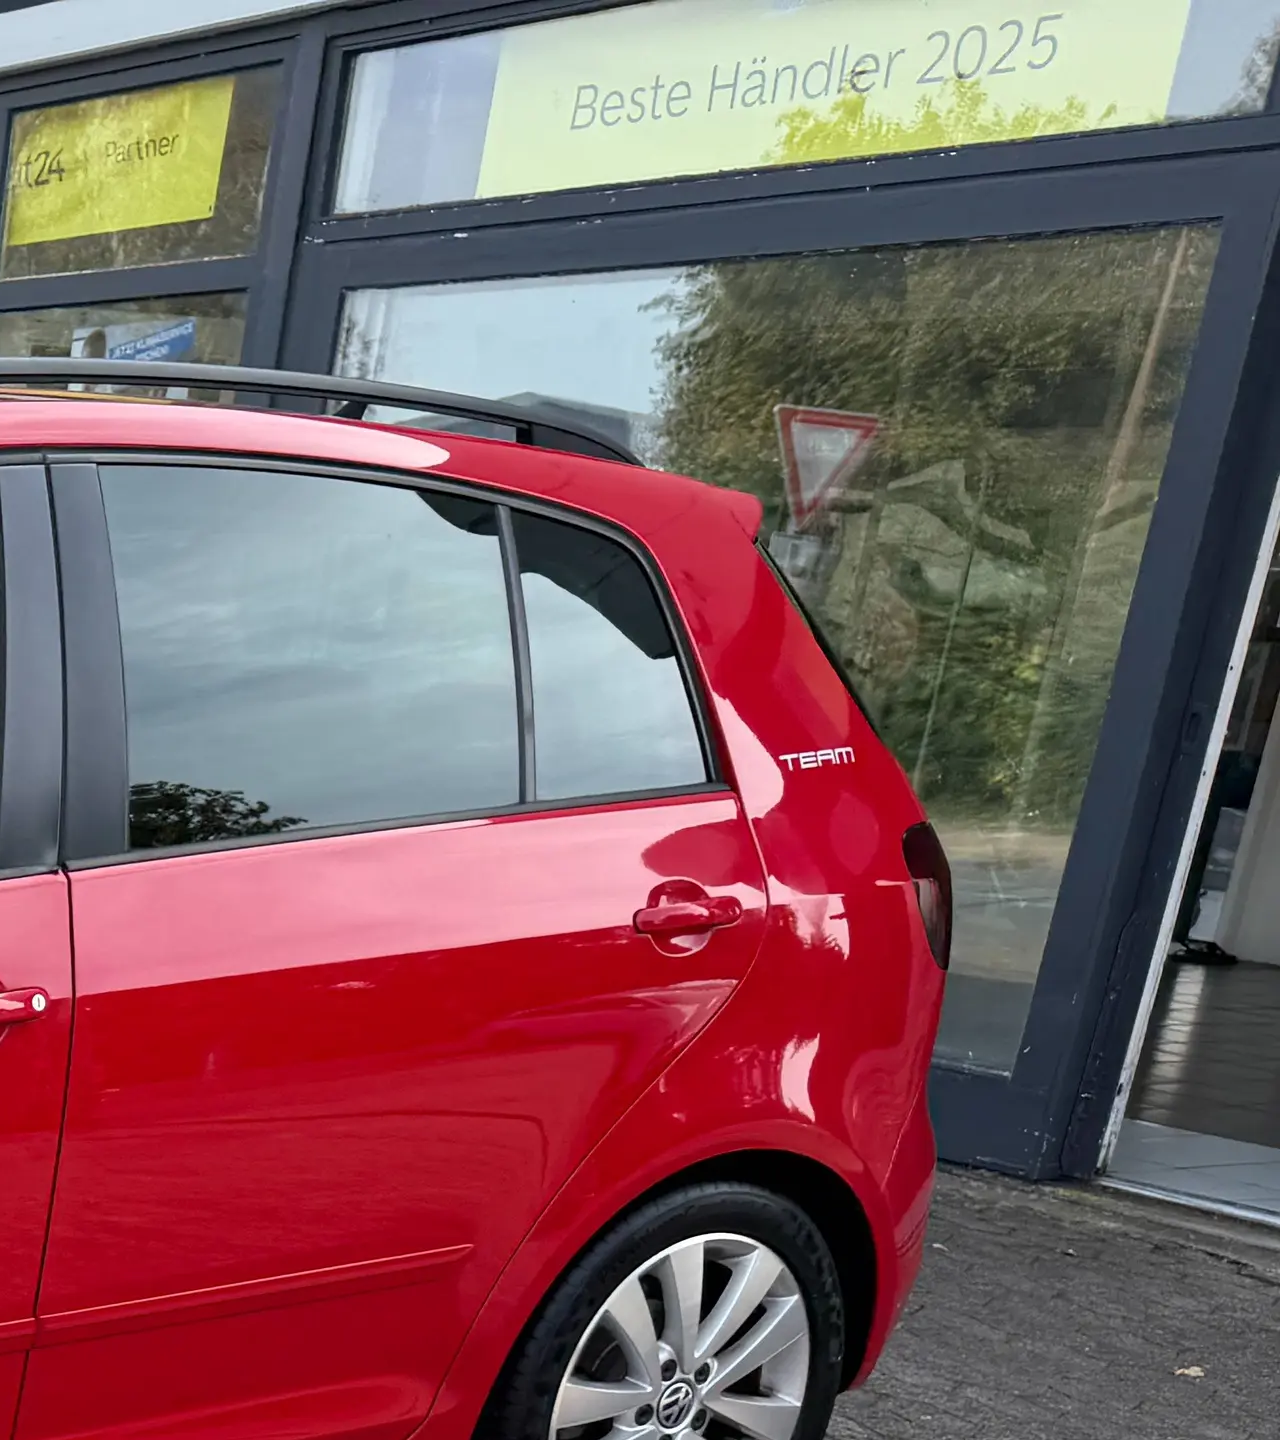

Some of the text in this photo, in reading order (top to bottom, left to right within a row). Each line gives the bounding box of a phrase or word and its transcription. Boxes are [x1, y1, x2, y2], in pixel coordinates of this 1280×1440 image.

[569, 12, 1064, 131] Beste Händler 2025
[105, 132, 179, 166] Partner
[778, 746, 856, 772] TEAM
